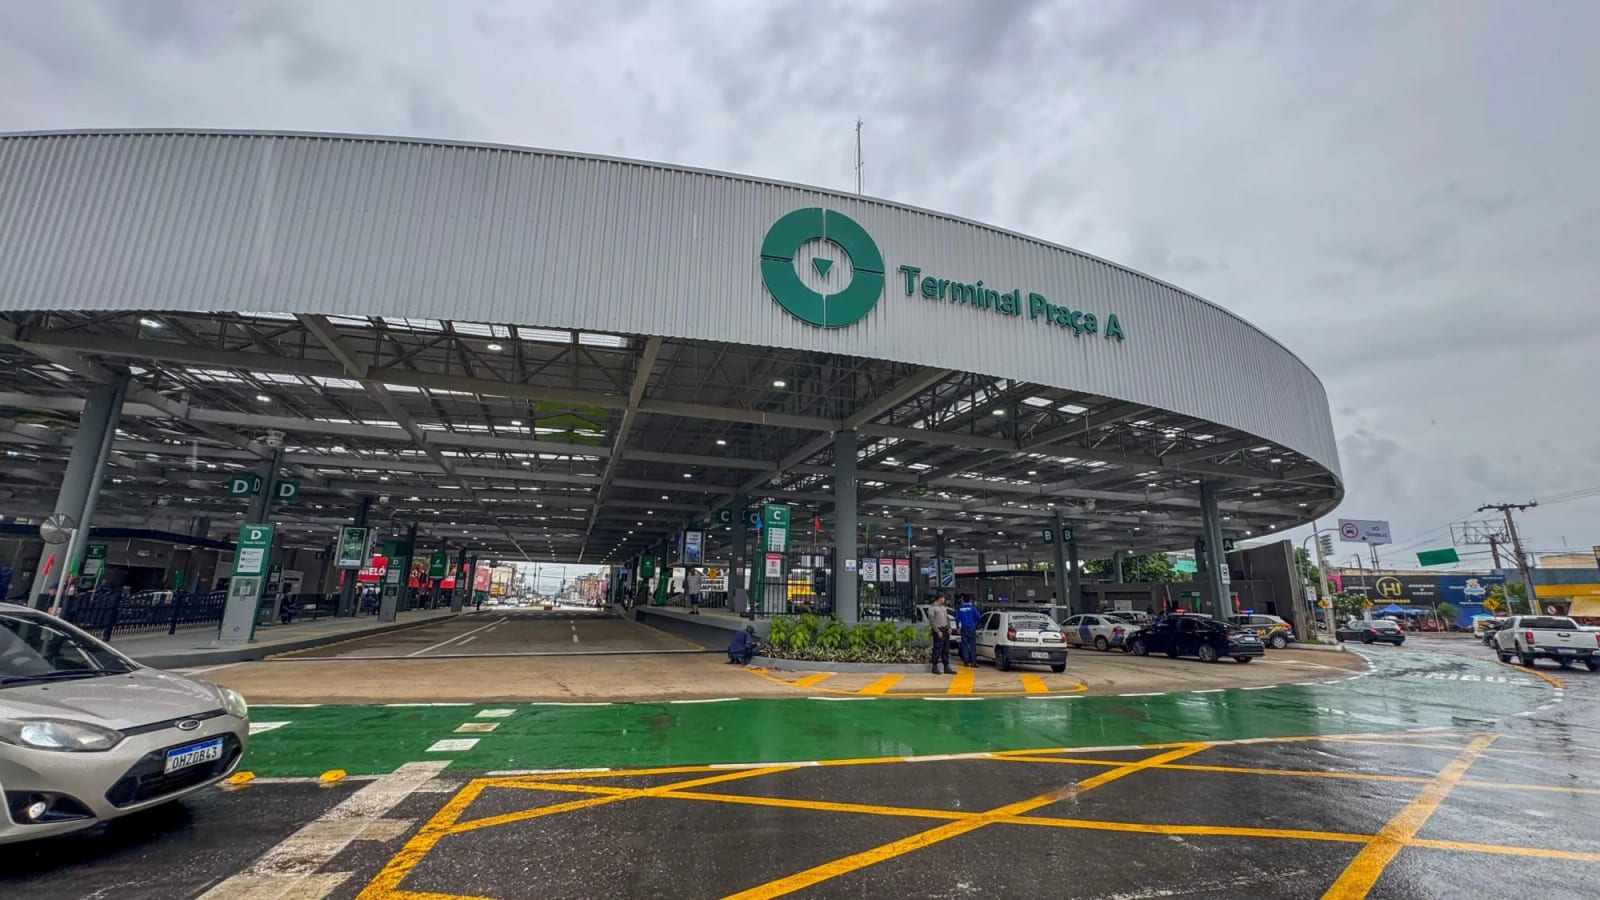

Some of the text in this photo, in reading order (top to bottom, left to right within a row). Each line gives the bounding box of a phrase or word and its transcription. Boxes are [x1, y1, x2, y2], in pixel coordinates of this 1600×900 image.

[900, 264, 1126, 342] Terminal Praça A
[232, 480, 249, 493] D
[280, 483, 296, 497] D
[721, 511, 730, 522] C
[773, 510, 781, 520] C
[250, 530, 262, 540] D
[1044, 530, 1052, 541] B
[1064, 529, 1072, 540] B
[1224, 539, 1233, 549] A
